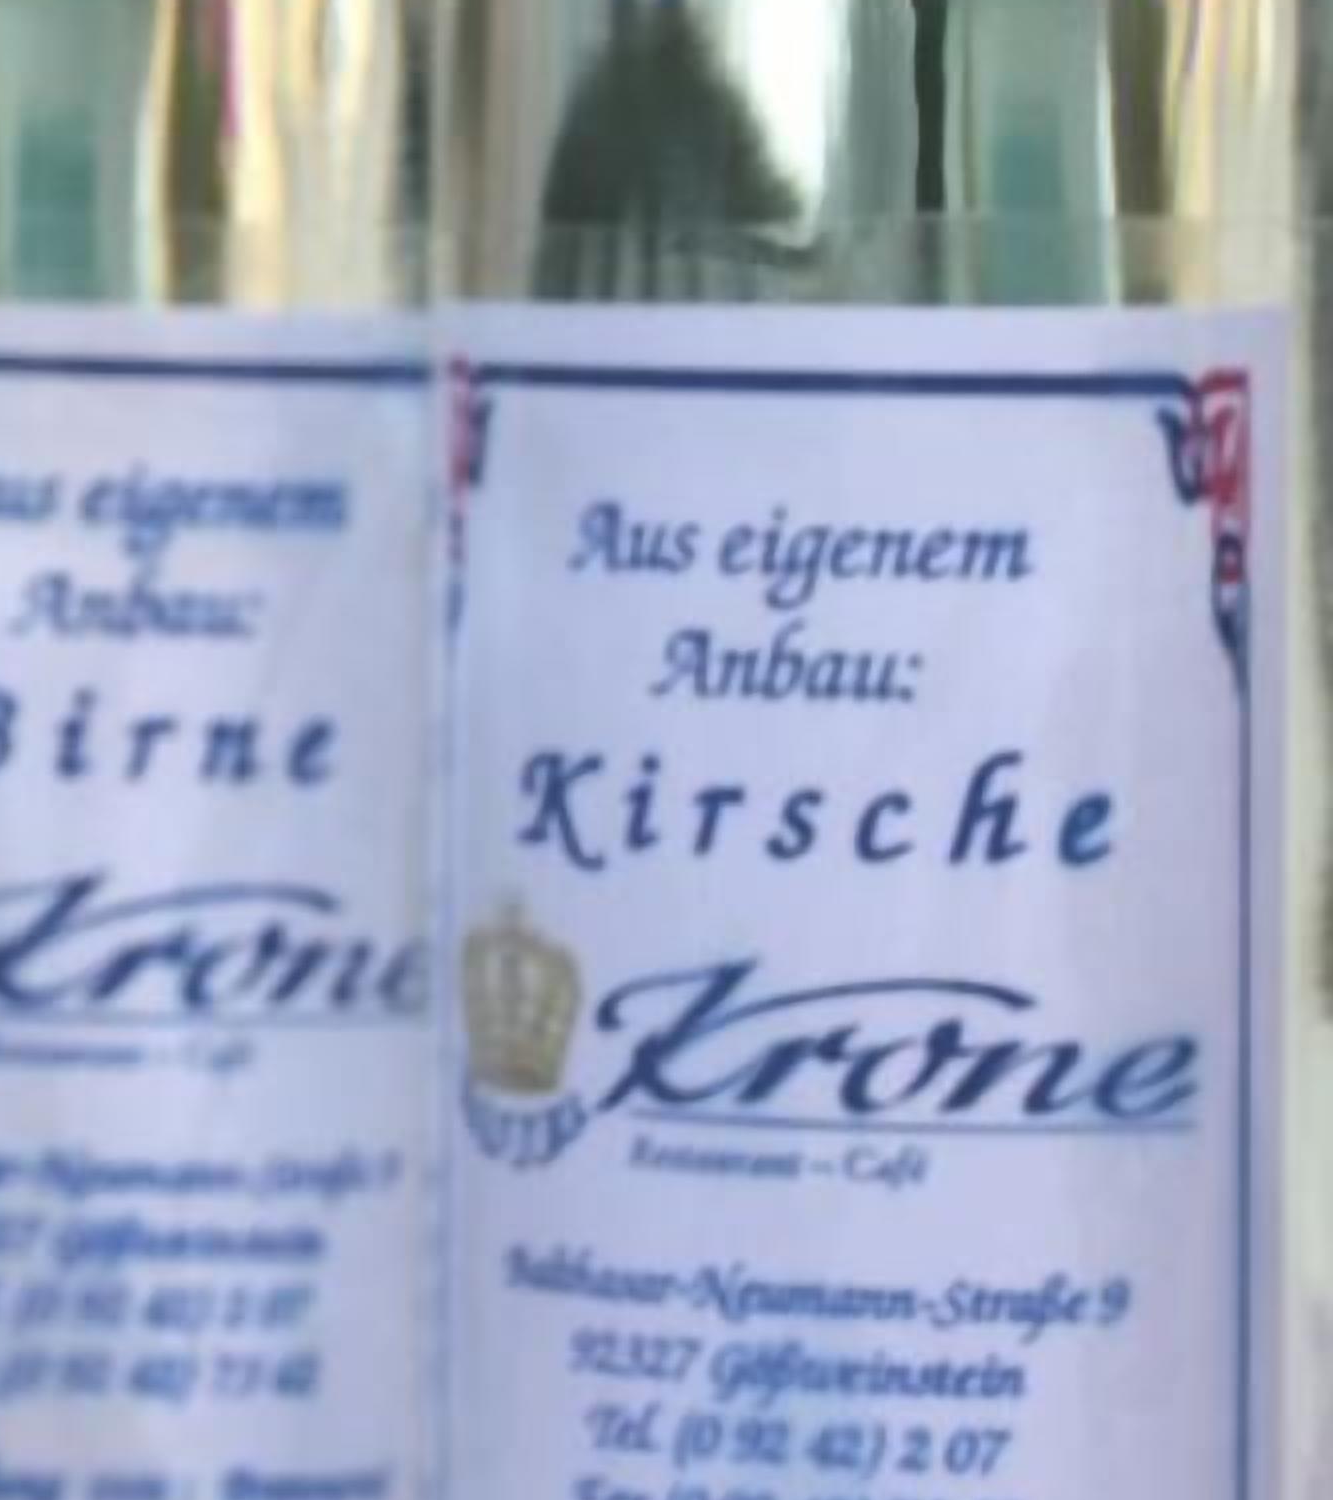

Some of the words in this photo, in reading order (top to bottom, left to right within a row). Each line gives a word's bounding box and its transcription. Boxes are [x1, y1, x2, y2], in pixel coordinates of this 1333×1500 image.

[568, 500, 701, 574] Aus
[716, 504, 1033, 610] eigenem
[649, 617, 925, 703] Anbau:
[515, 746, 1114, 873] Kirsche
[593, 954, 1200, 1119] Krone
[1098, 1279, 1131, 1328] 9
